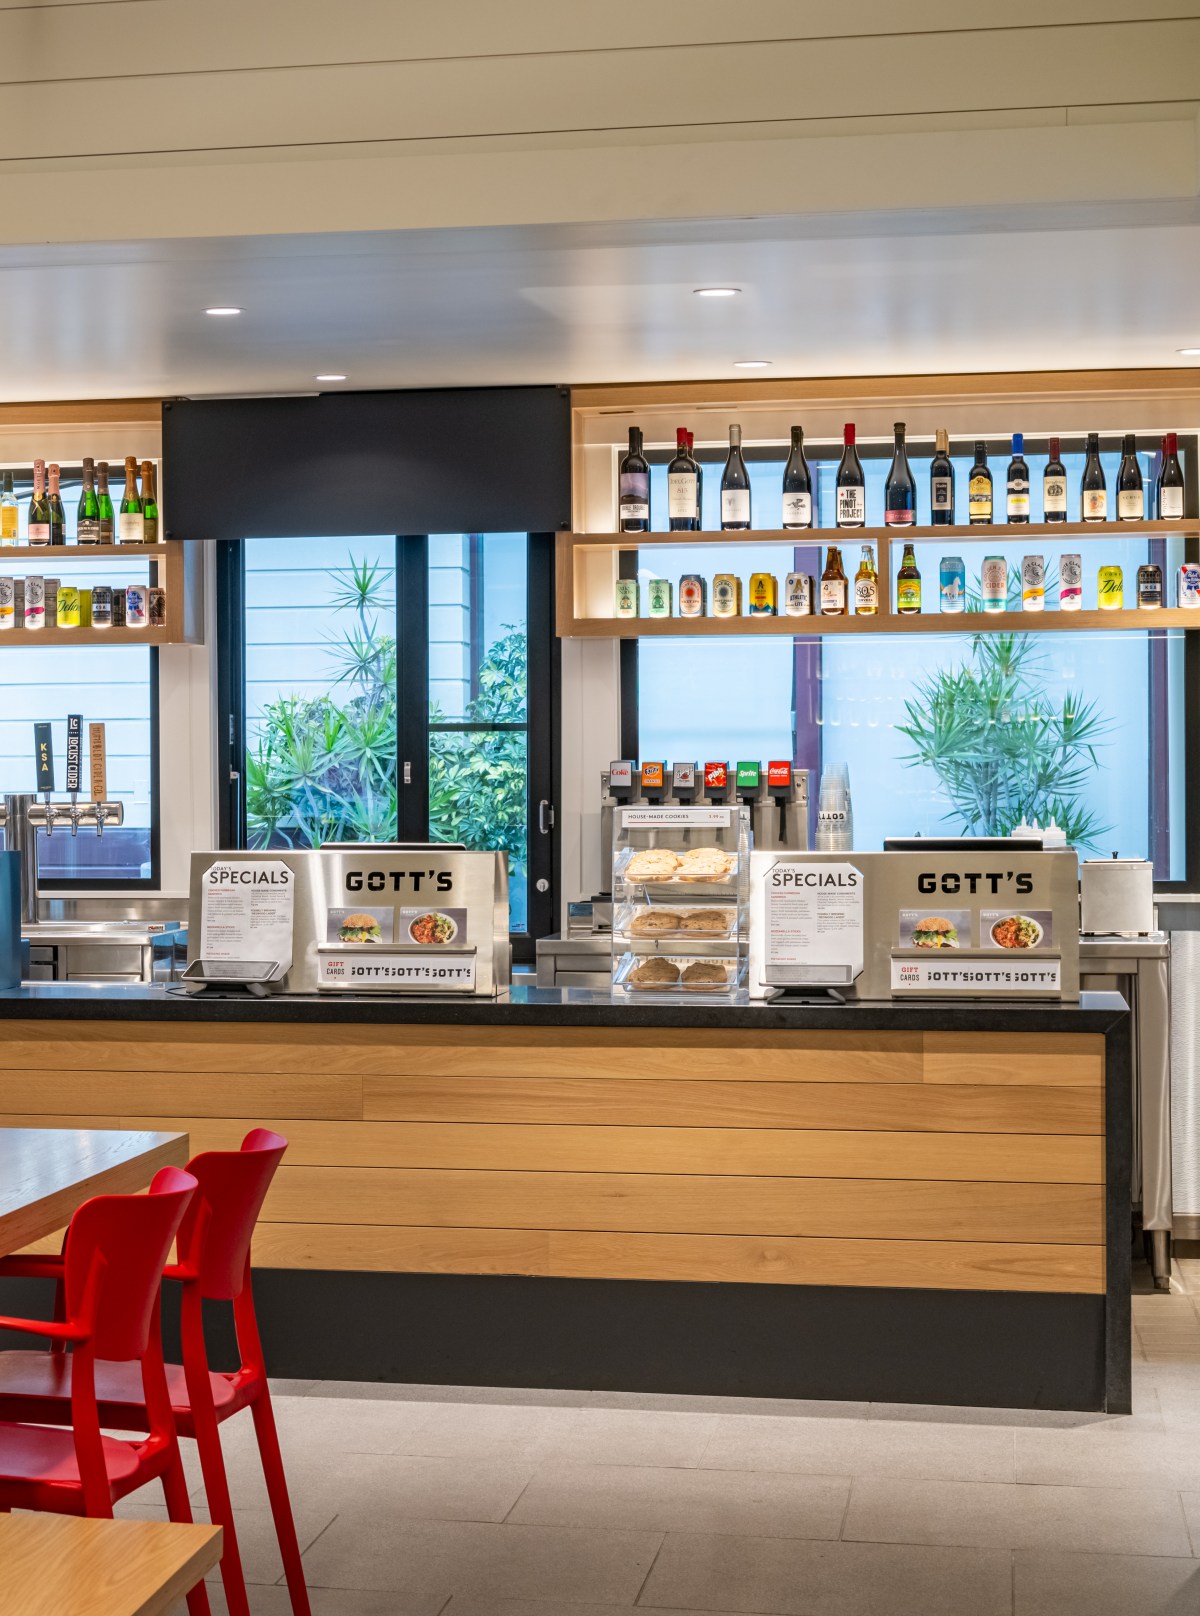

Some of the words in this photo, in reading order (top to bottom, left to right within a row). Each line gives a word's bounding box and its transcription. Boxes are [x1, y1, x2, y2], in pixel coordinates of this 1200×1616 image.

[846, 490, 856, 498] THE
[840, 500, 856, 508] PINOT
[840, 508, 862, 518] PROJECT
[856, 586, 874, 596] 805
[68, 736, 78, 764] LOCUST
[40, 743, 48, 772] KSA
[68, 765, 78, 788] CIDER
[738, 770, 756, 778] Sprite
[210, 871, 288, 884] SPECIALS
[346, 870, 452, 892] GOTT'S
[772, 873, 857, 886] SPECIALS
[918, 872, 1033, 894] GOTT'S
